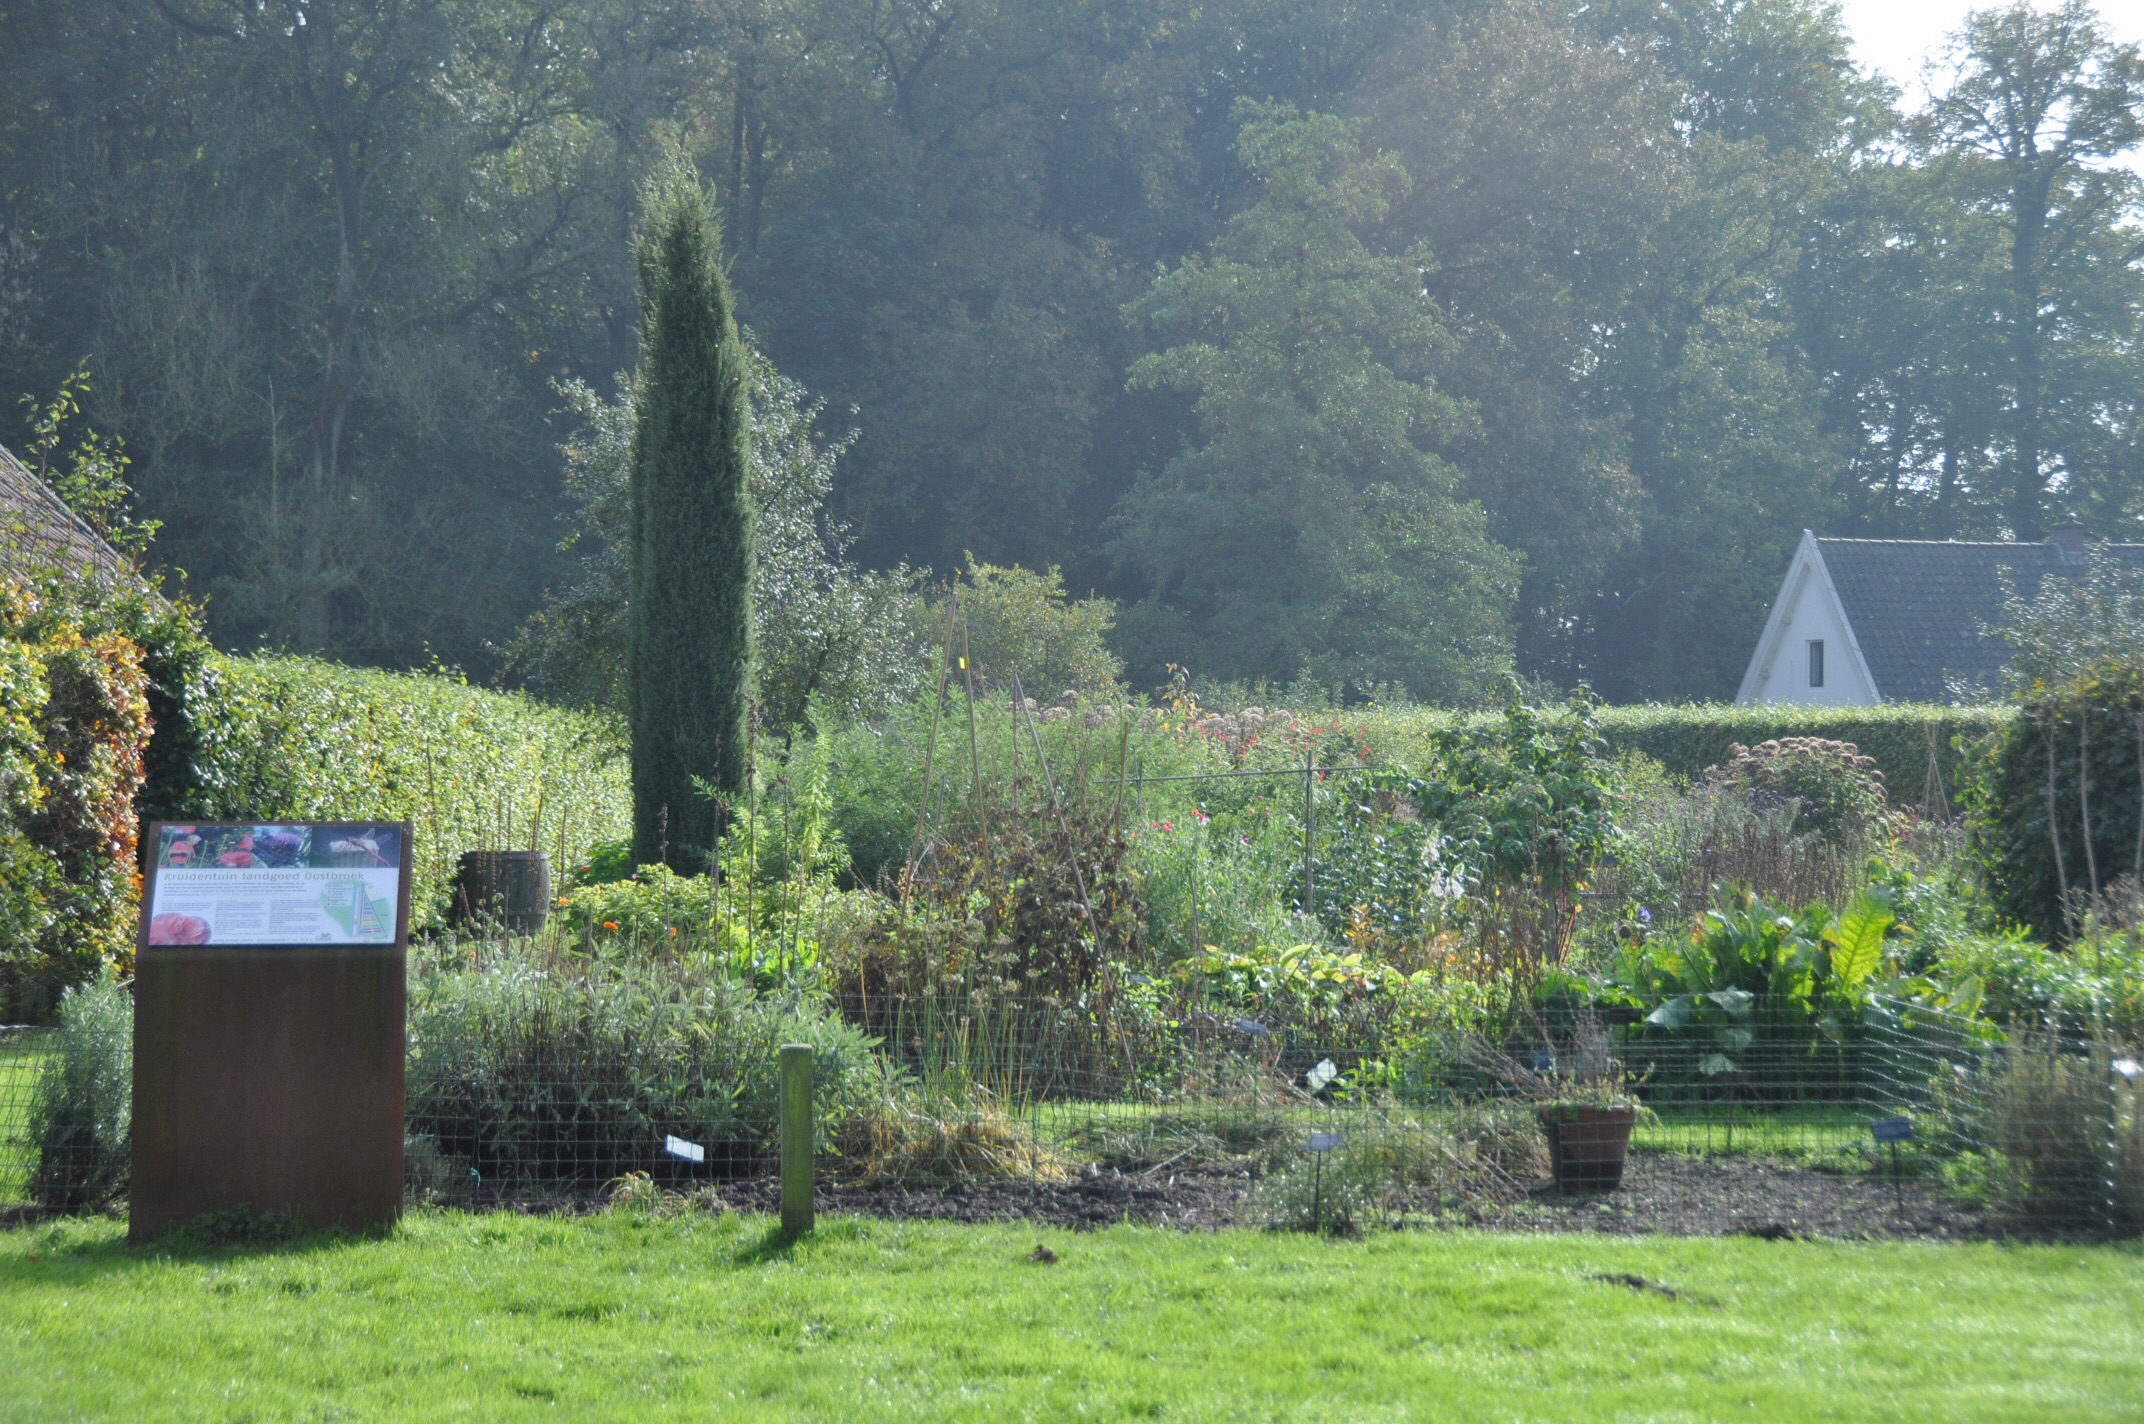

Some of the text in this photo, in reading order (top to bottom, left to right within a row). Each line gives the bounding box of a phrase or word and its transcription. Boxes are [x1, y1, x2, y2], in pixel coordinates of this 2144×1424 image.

[164, 872, 365, 882] Kruidentuin landgoed Oostbroek
